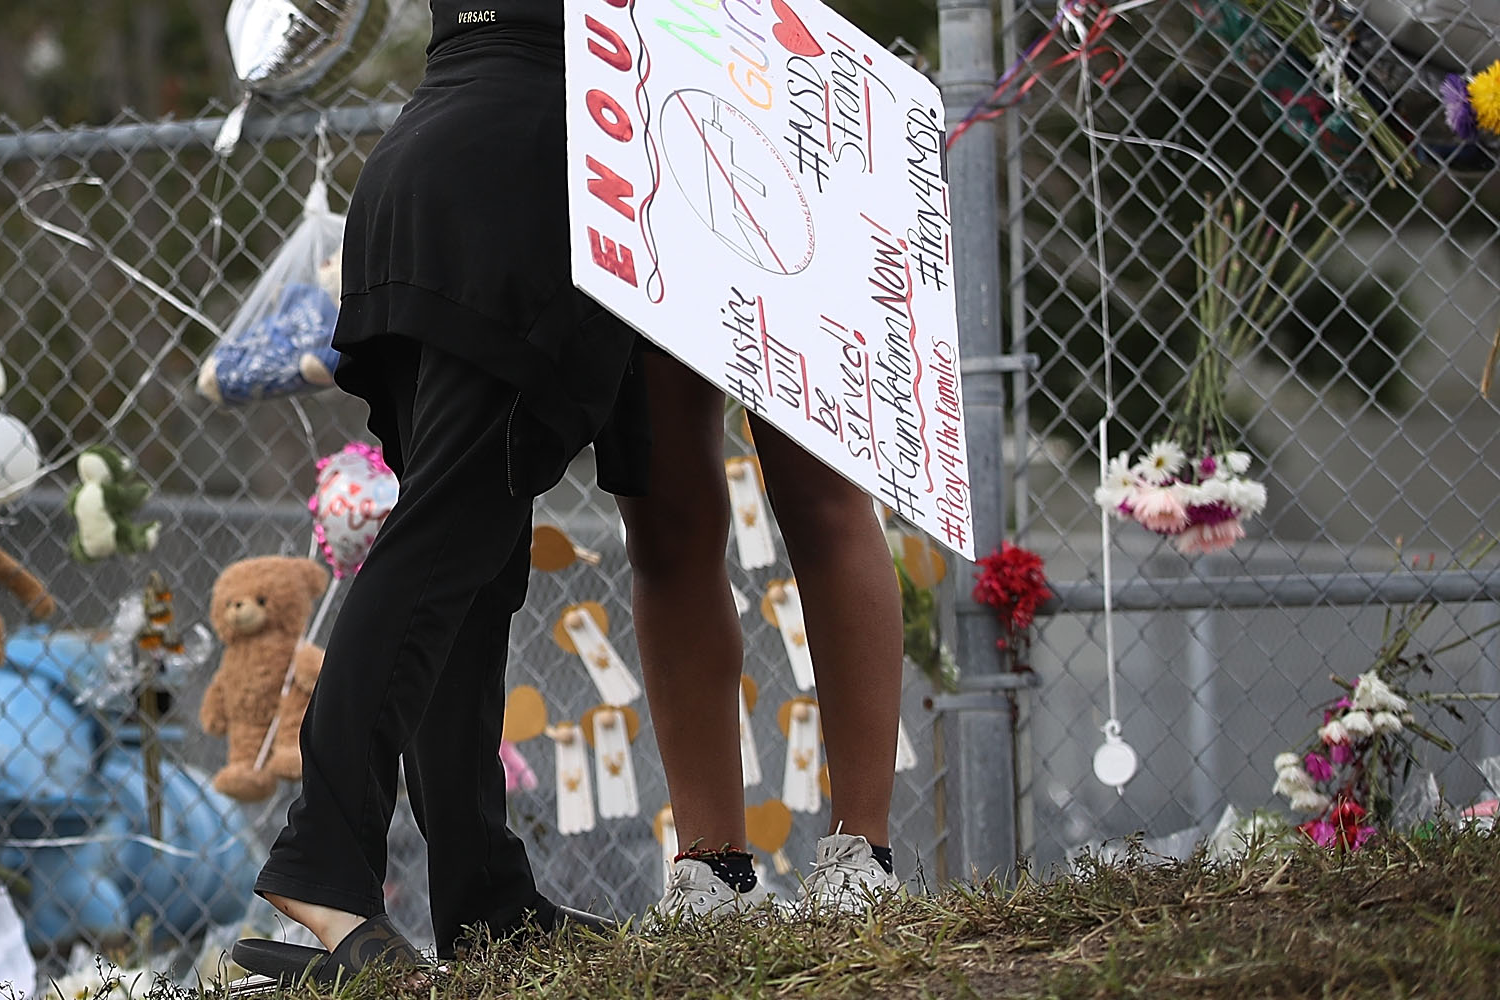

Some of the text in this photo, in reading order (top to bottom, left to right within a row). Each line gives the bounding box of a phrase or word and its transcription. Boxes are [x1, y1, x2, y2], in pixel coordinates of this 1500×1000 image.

[458, 10, 496, 24] VERSACE
[783, 55, 830, 194] #MSD
[810, 387, 839, 436] be
